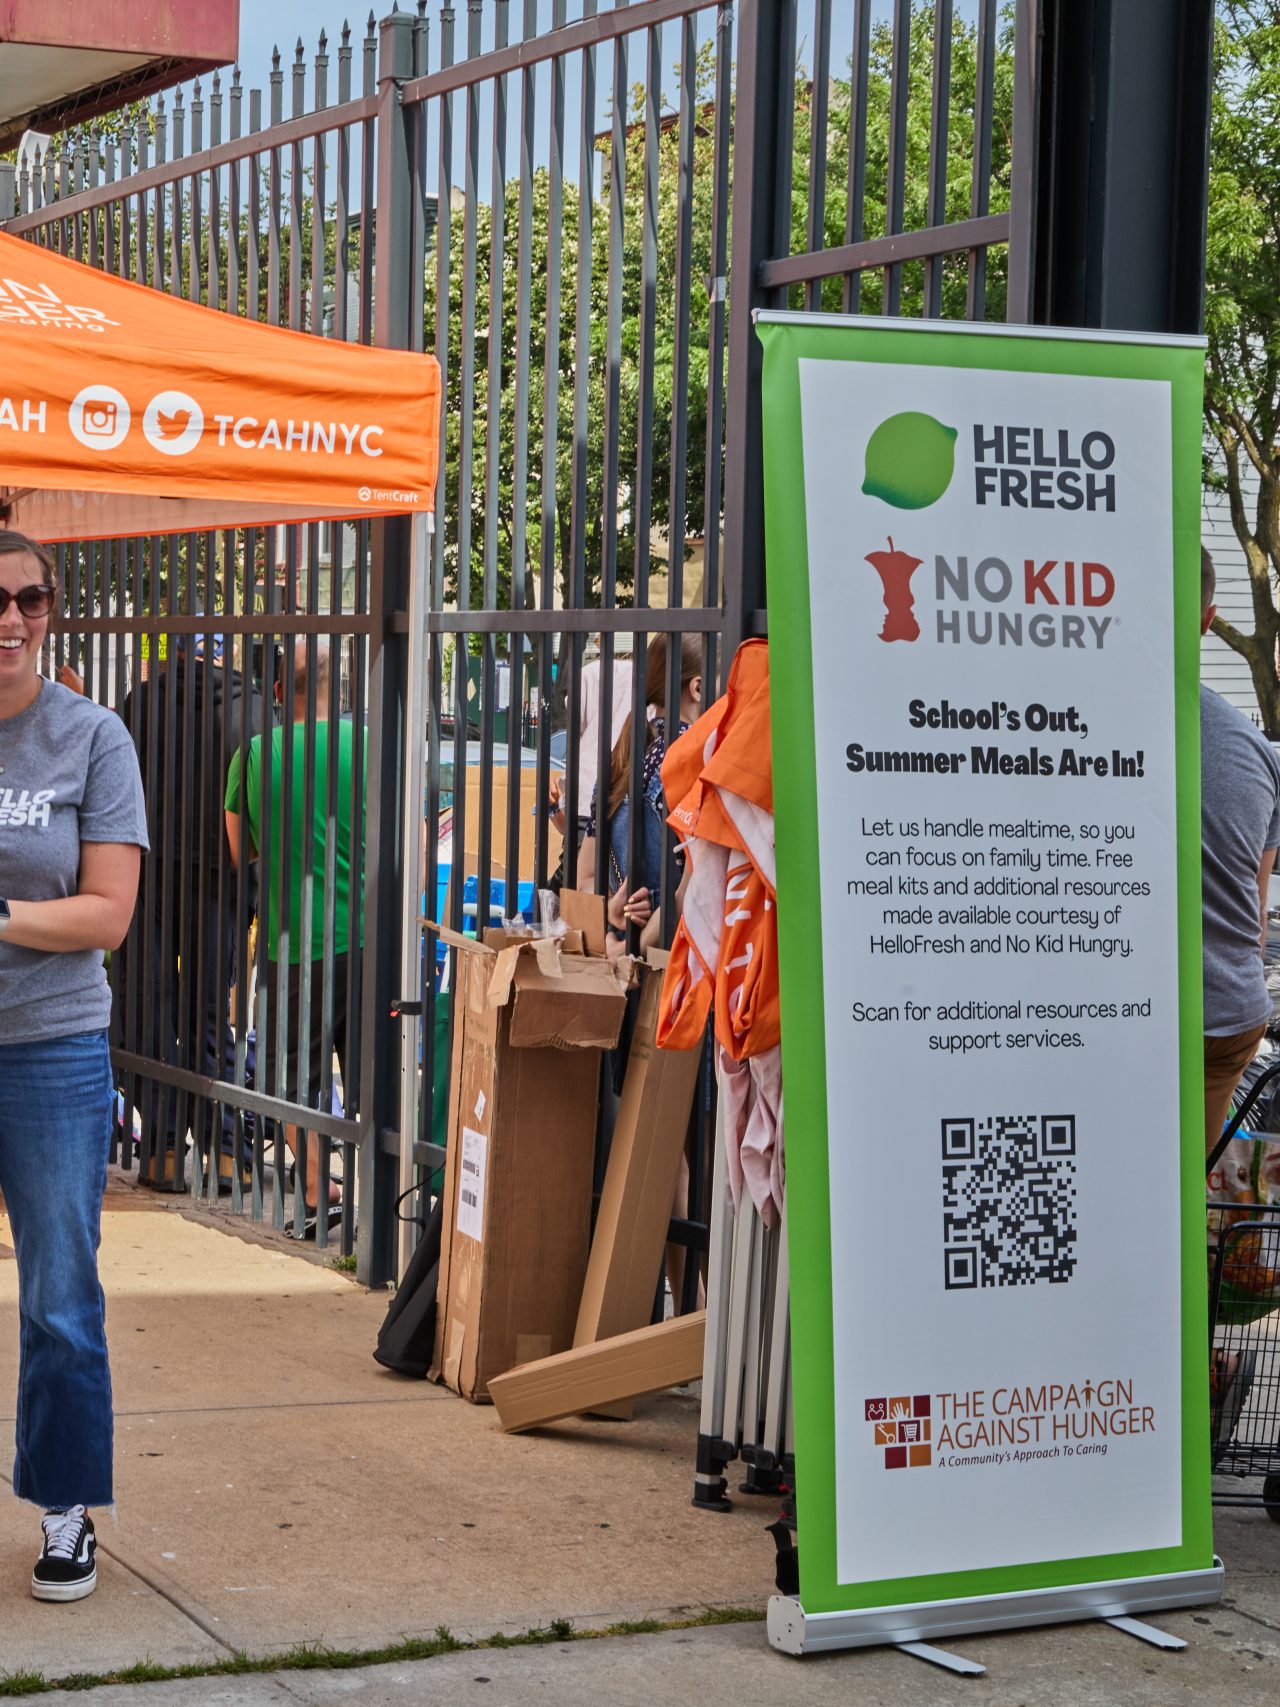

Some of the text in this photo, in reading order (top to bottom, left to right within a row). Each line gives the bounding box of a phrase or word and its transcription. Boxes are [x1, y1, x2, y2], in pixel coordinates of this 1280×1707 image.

[214, 415, 384, 456] TCAHNYC
[973, 424, 1115, 470] HELLO
[372, 490, 418, 503] TentCraft
[975, 467, 1115, 512] FRESH
[934, 555, 1115, 607] NO KID
[909, 699, 1088, 739] School’s Out,
[846, 743, 1144, 778] Summer Meals Are In!
[862, 818, 1135, 844] Let us handle mealtime, so you
[866, 846, 1133, 872] can focus on family time. Free
[848, 875, 1150, 896] meal kits and additional resources
[883, 905, 1122, 929] made available courtesy of
[871, 934, 1133, 958] HelloFresh and No Kid Hungry.
[853, 998, 1151, 1022] Scan for additional resources and
[929, 1029, 1084, 1054] support services.
[936, 1391, 984, 1420] THE
[937, 1406, 1155, 1451] AGAINST HUNGER
[939, 1457, 945, 1468] A
[1014, 1447, 1060, 1463] Approach
[1063, 1446, 1073, 1456] To
[1076, 1444, 1108, 1456] Caring
